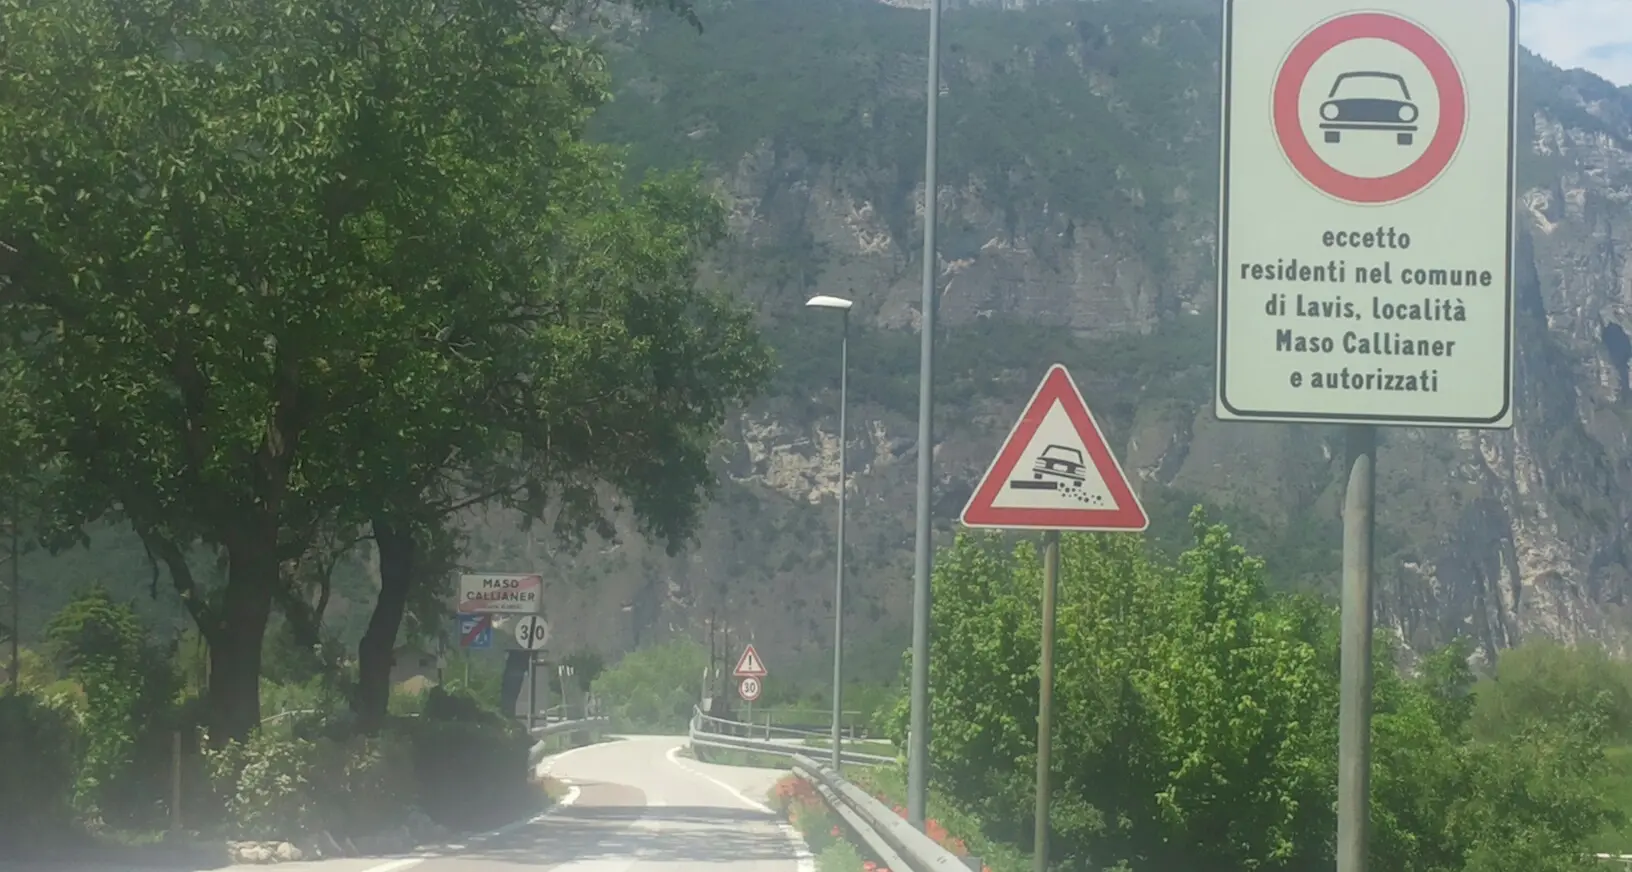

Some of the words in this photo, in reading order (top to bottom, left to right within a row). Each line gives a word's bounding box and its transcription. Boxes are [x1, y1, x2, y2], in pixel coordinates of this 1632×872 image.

[1322, 226, 1411, 249] eccetto
[1241, 258, 1345, 283] residenti
[1355, 262, 1392, 284] nel
[1401, 268, 1492, 286] comune
[1265, 293, 1285, 316] di
[1297, 294, 1361, 321] Lavis,
[1373, 297, 1466, 321] località
[1276, 329, 1334, 353] Maso
[1343, 331, 1456, 356] Callianer
[1290, 371, 1302, 387] e
[1311, 368, 1438, 392] autorizzati
[483, 578, 519, 588] MASO
[466, 591, 535, 601] CALLIANER
[520, 625, 544, 640] 30
[744, 682, 756, 693] 30
